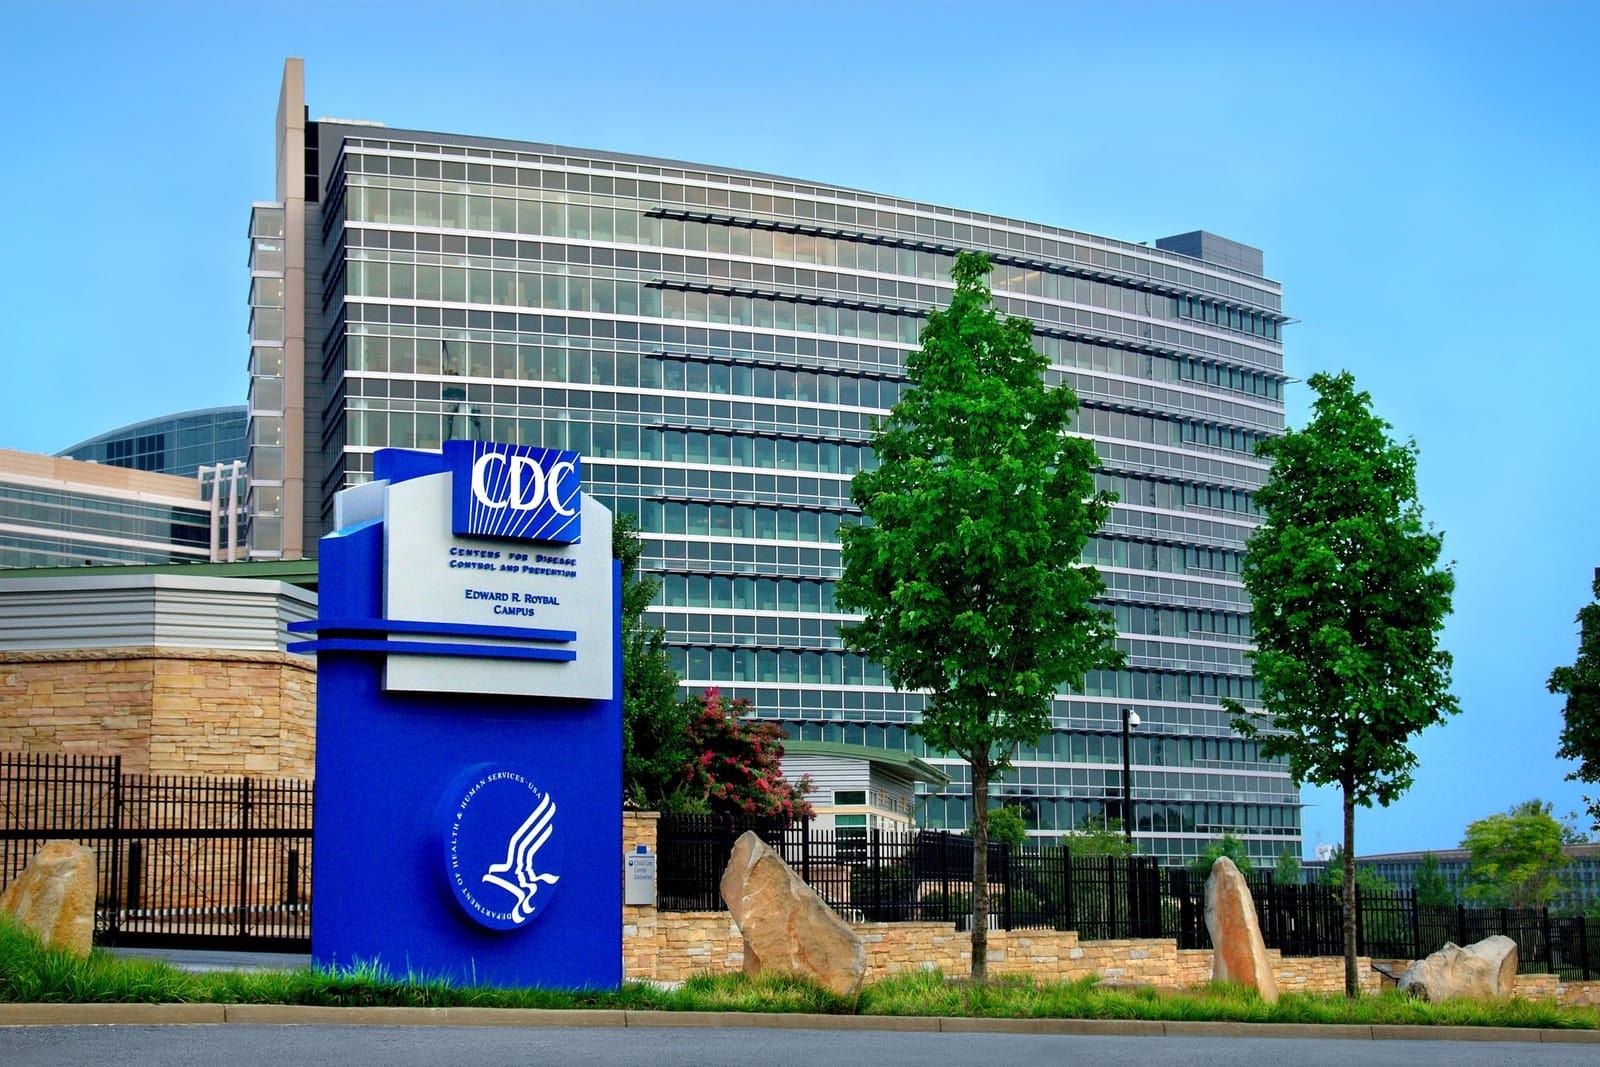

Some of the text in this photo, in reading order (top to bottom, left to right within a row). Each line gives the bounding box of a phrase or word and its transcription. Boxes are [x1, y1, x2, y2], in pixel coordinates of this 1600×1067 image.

[472, 453, 575, 516] CDC
[450, 547, 577, 566] CENTERS FOR DISEASE
[449, 560, 577, 578] CONTROL AND PREVENTION
[465, 589, 560, 605] EDWARD R. ROYBAL
[494, 605, 535, 616] CAMPUS
[487, 772, 525, 784] SERVICES
[461, 779, 487, 809] HUMAN
[451, 823, 460, 869] HEALTH
[454, 872, 464, 886] OF
[462, 887, 512, 920] DEPARTMENT
